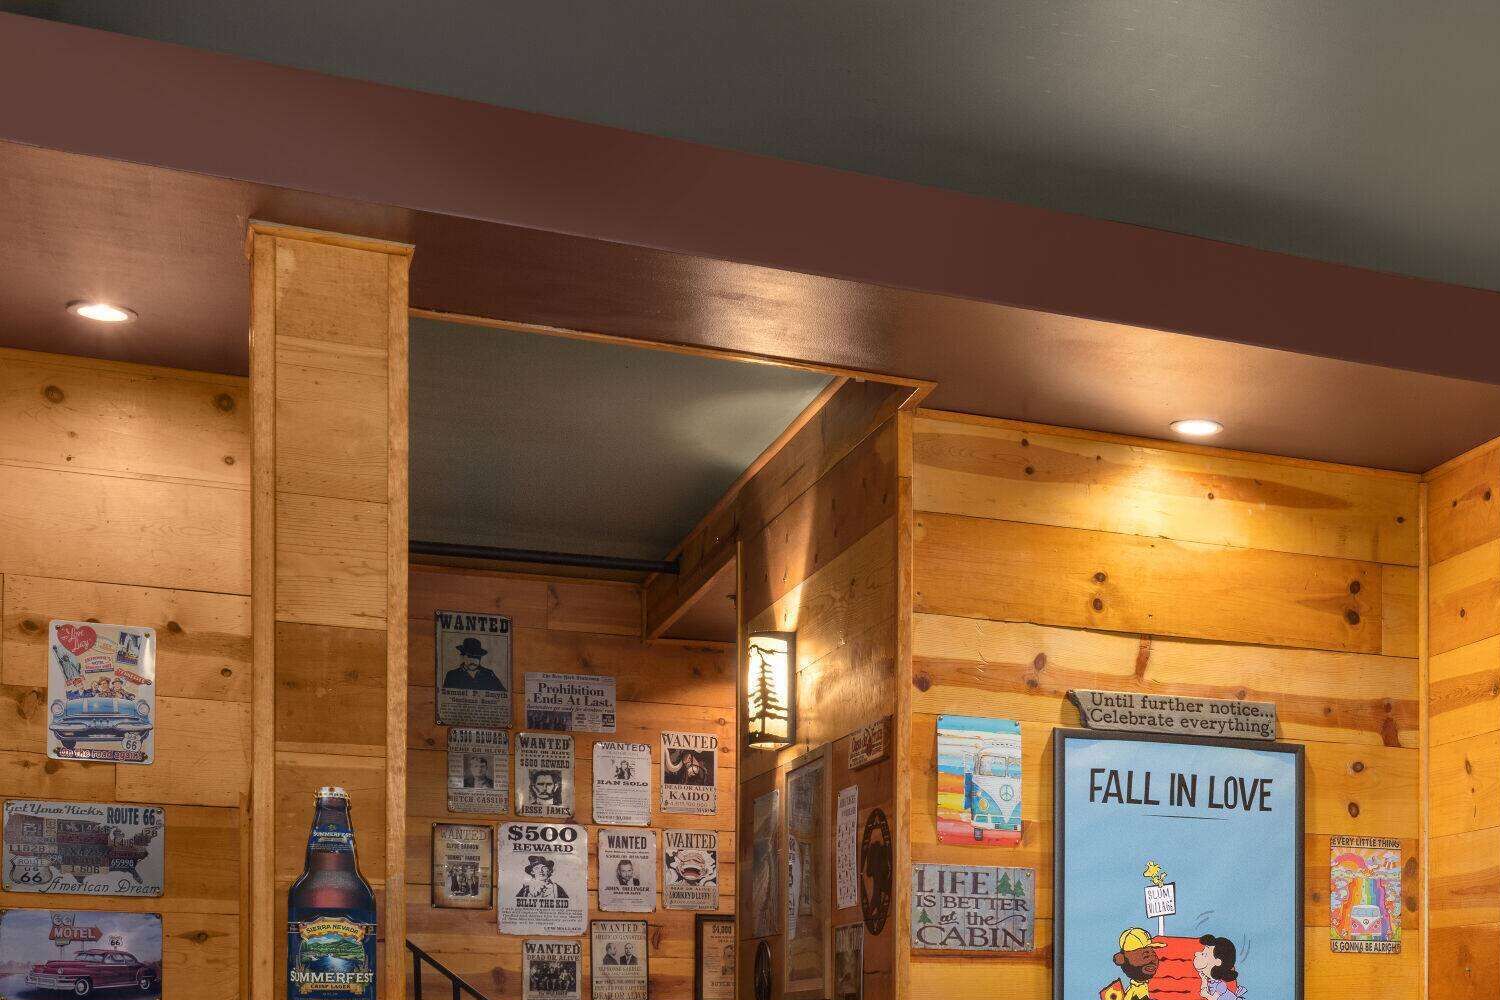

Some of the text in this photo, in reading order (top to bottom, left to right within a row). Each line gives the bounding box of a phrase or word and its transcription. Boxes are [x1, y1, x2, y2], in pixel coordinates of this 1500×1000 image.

[440, 613, 508, 633] WANTED
[538, 682, 604, 697] Prohibition
[533, 692, 562, 704] Ends
[567, 695, 580, 705] At
[1089, 691, 1274, 719] Until further notice...
[1090, 708, 1274, 737] Celebrate everything.
[126, 740, 137, 750] 66
[520, 737, 570, 750] WANTED
[601, 742, 646, 752] WANTED
[661, 733, 718, 749] WANTED
[669, 790, 710, 802] KAIDO
[1089, 768, 1274, 812] FALL IN LOVE
[107, 807, 139, 825] ROUTE
[143, 808, 156, 825] 66
[521, 805, 571, 816] JESSE JAMES
[508, 825, 578, 842] $500
[666, 832, 716, 849] WANTED
[512, 843, 574, 853] REWARD
[607, 835, 647, 849] WANTED
[1331, 837, 1353, 846] EVERY
[1355, 838, 1377, 848] LITTLE
[21, 872, 43, 883] 66
[917, 869, 990, 895] LIFE
[39, 876, 161, 894] American Dream
[1148, 887, 1170, 901] SLUM
[516, 899, 569, 908] BILLY THE KID
[915, 894, 1030, 912] IS BETTER
[1148, 900, 1174, 914] VILLAGE
[939, 911, 1012, 926] at the
[53, 927, 96, 939] MOTEL
[306, 924, 359, 934] SIERRA NEVADA
[600, 923, 638, 931] WANTED
[916, 925, 1027, 948] CABIN
[525, 943, 581, 954] WANTED
[1332, 941, 1338, 950] IS
[1340, 941, 1364, 951] GONNA
[1365, 942, 1373, 951] BE
[290, 969, 374, 983] SUMMERFEST
